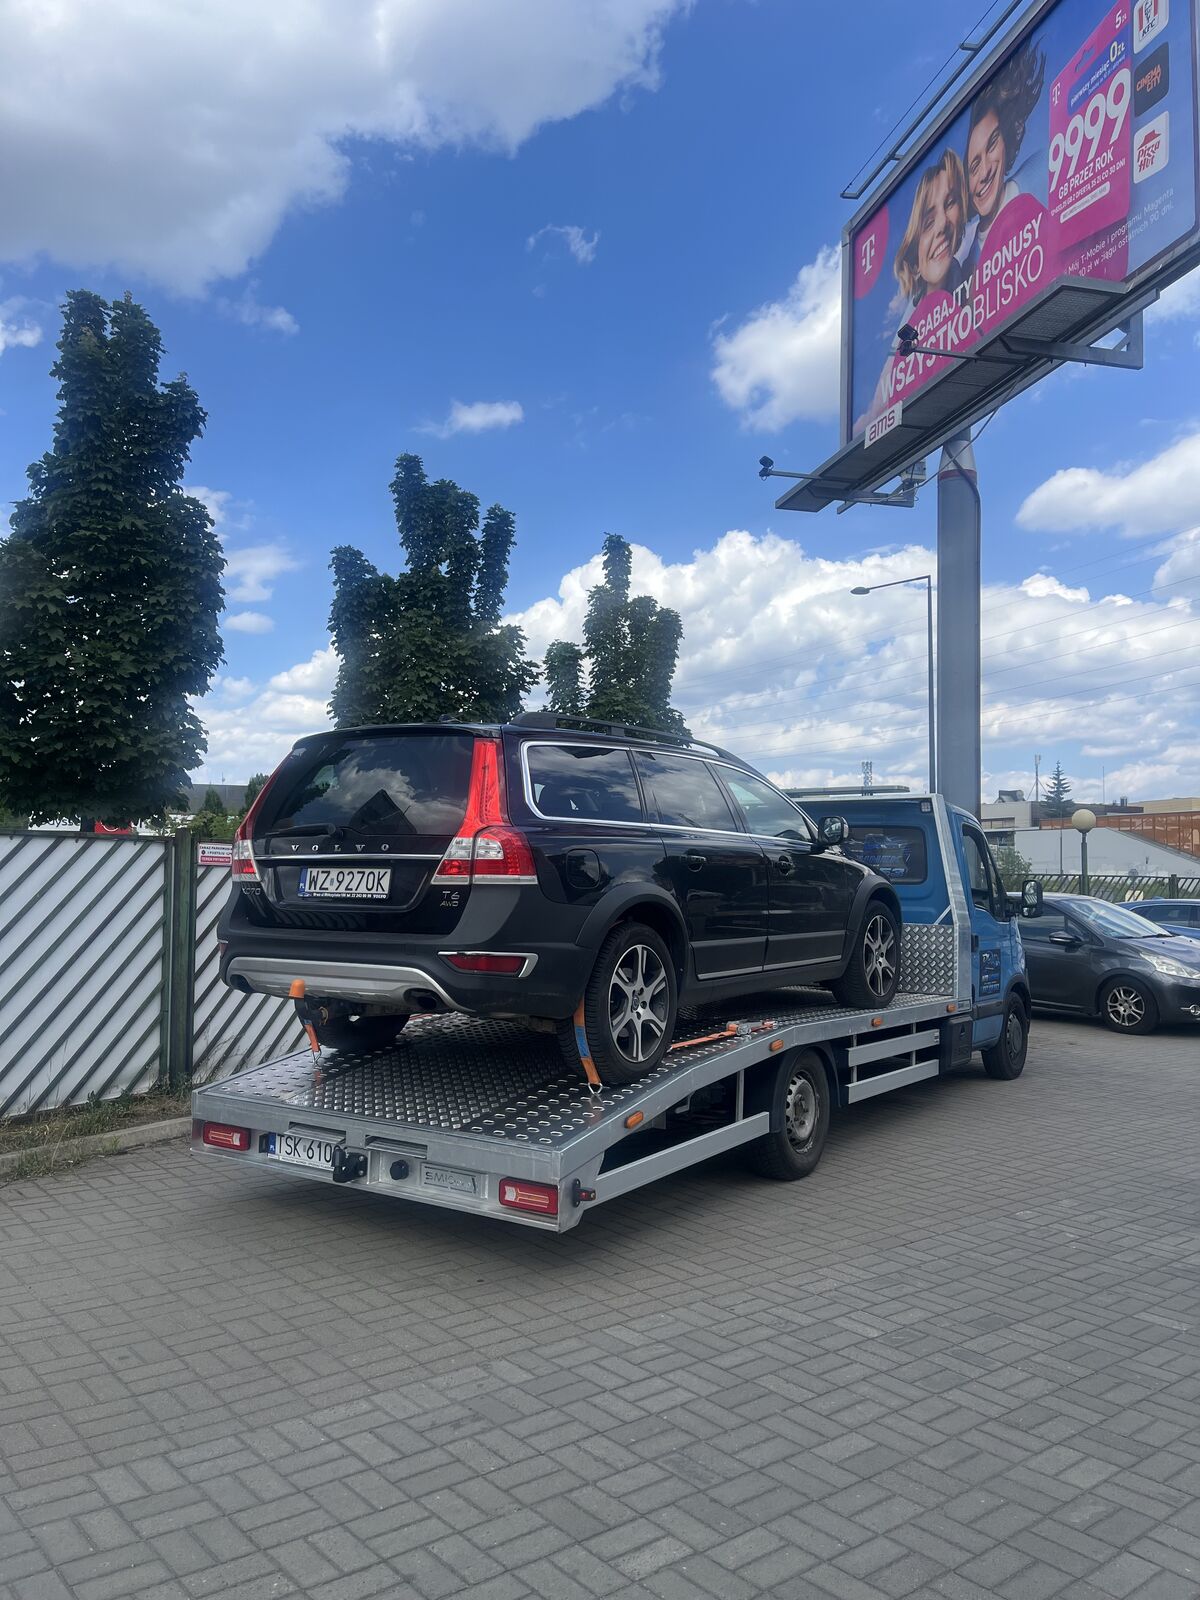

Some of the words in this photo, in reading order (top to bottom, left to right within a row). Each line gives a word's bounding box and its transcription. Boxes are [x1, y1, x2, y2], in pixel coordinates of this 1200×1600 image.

[1142, 18, 1156, 38] KFC
[1136, 64, 1161, 92] CINEMA
[1147, 75, 1162, 92] CITY
[1048, 67, 1131, 194] 9999
[1058, 182, 1069, 200] GB
[1069, 162, 1094, 192] PRZEZ
[1095, 145, 1114, 173] ROK
[1110, 212, 1142, 243] programu
[1143, 187, 1174, 217] Magenta
[861, 233, 875, 275] T
[975, 268, 980, 293] I
[982, 211, 1043, 286] BONUSY
[869, 409, 895, 442] ams
[290, 843, 390, 853] VOLVO
[308, 869, 331, 891] WZ
[335, 870, 388, 892] 9270K
[442, 890, 460, 900] T6
[277, 1133, 302, 1158] TSK
